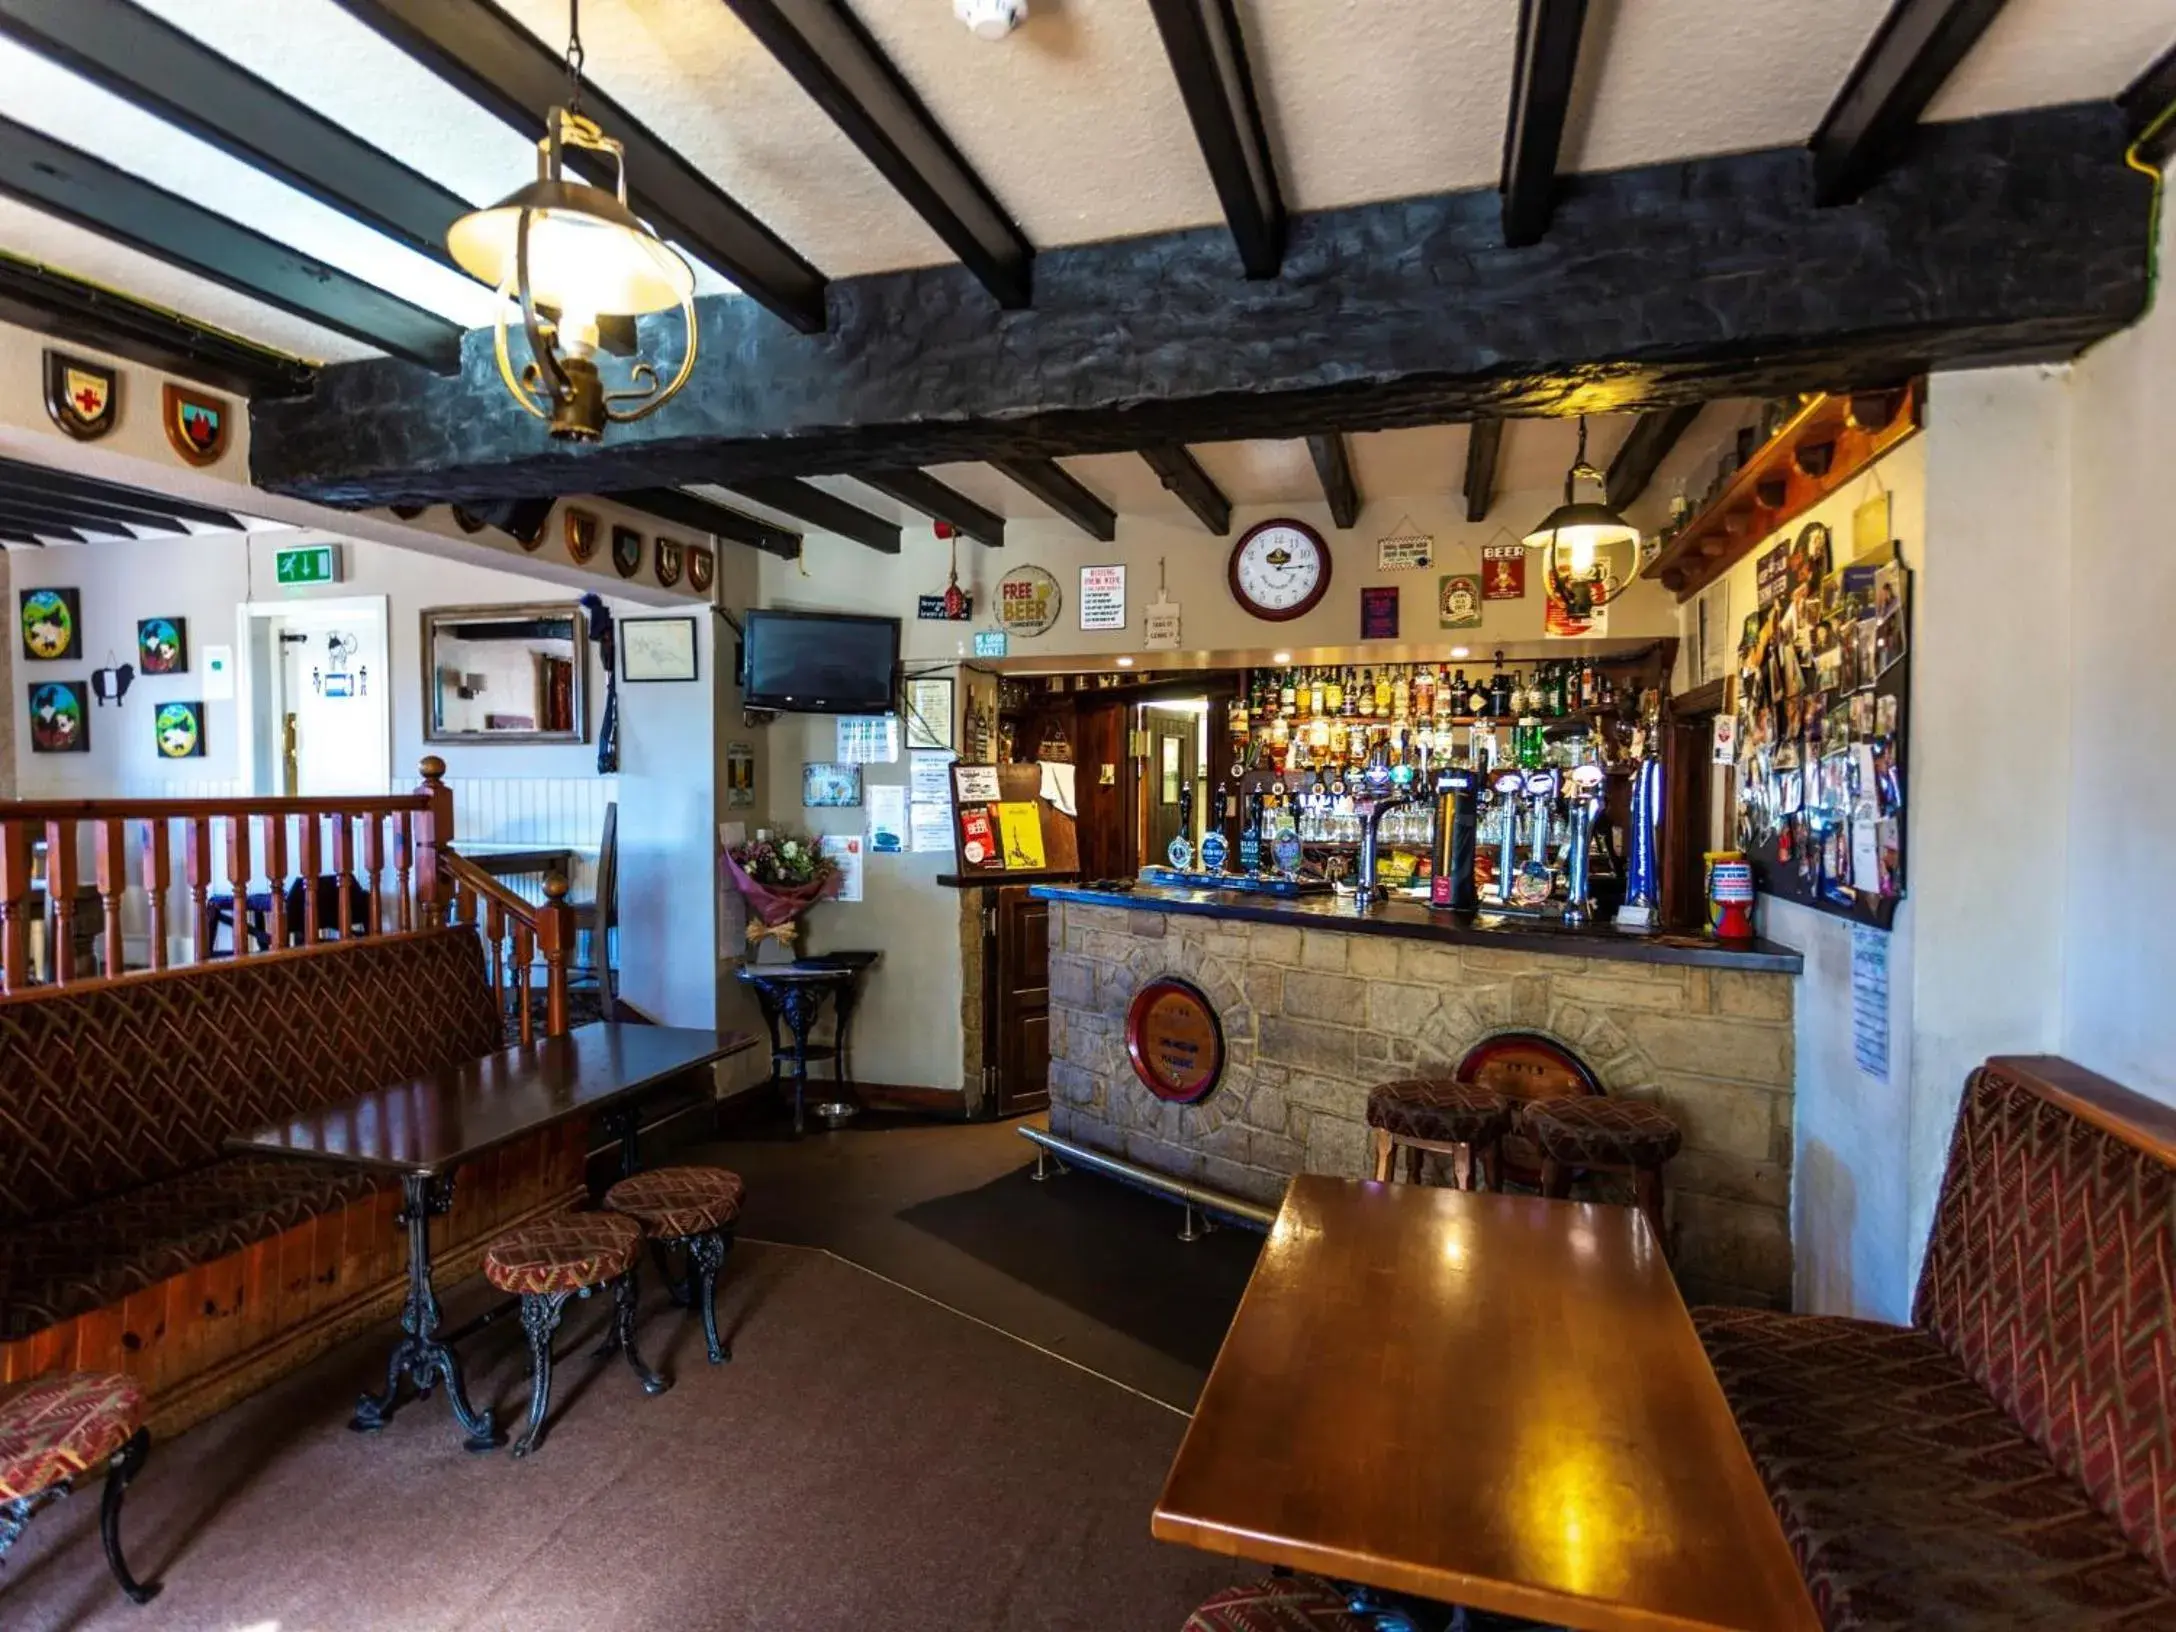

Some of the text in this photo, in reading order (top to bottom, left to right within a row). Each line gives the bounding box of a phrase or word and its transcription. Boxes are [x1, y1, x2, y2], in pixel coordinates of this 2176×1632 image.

[1274, 534, 1284, 544] 12
[1290, 538, 1298, 548] 11
[1300, 550, 1310, 558] 10
[1484, 546, 1524, 558] BEER
[1003, 582, 1032, 600] FREE
[1003, 600, 1047, 621] BEER
